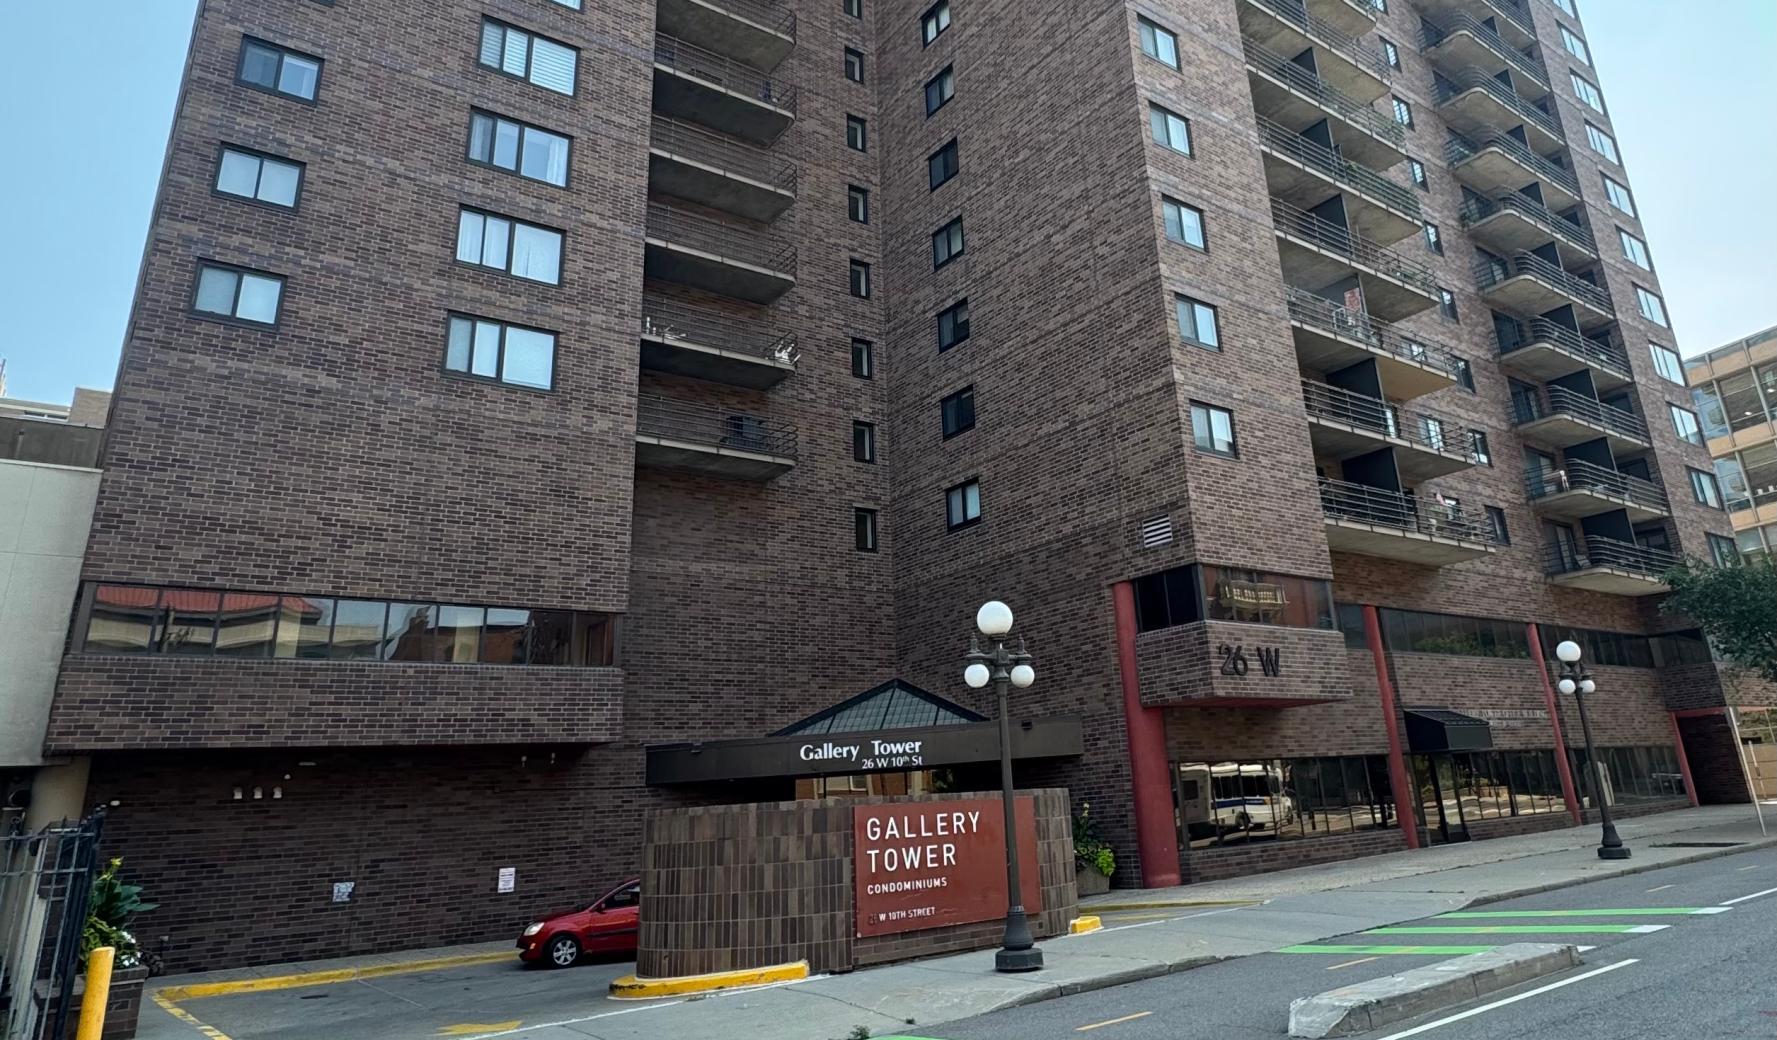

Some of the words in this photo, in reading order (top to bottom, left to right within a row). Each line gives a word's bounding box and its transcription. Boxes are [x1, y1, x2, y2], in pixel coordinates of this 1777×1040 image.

[1219, 643, 1248, 676] 26
[1256, 646, 1280, 677] W
[800, 743, 859, 761] Gallery
[871, 740, 921, 756] Tower
[862, 758, 874, 769] 26
[877, 758, 889, 768] W
[892, 755, 909, 767] 10th
[912, 755, 922, 766] St
[866, 811, 980, 841] GALLERY
[866, 843, 956, 873] TOWER
[867, 877, 947, 895] CONDOMINIUMS
[879, 913, 886, 922] W
[889, 910, 906, 921] 10TH
[908, 906, 935, 918] STREET
